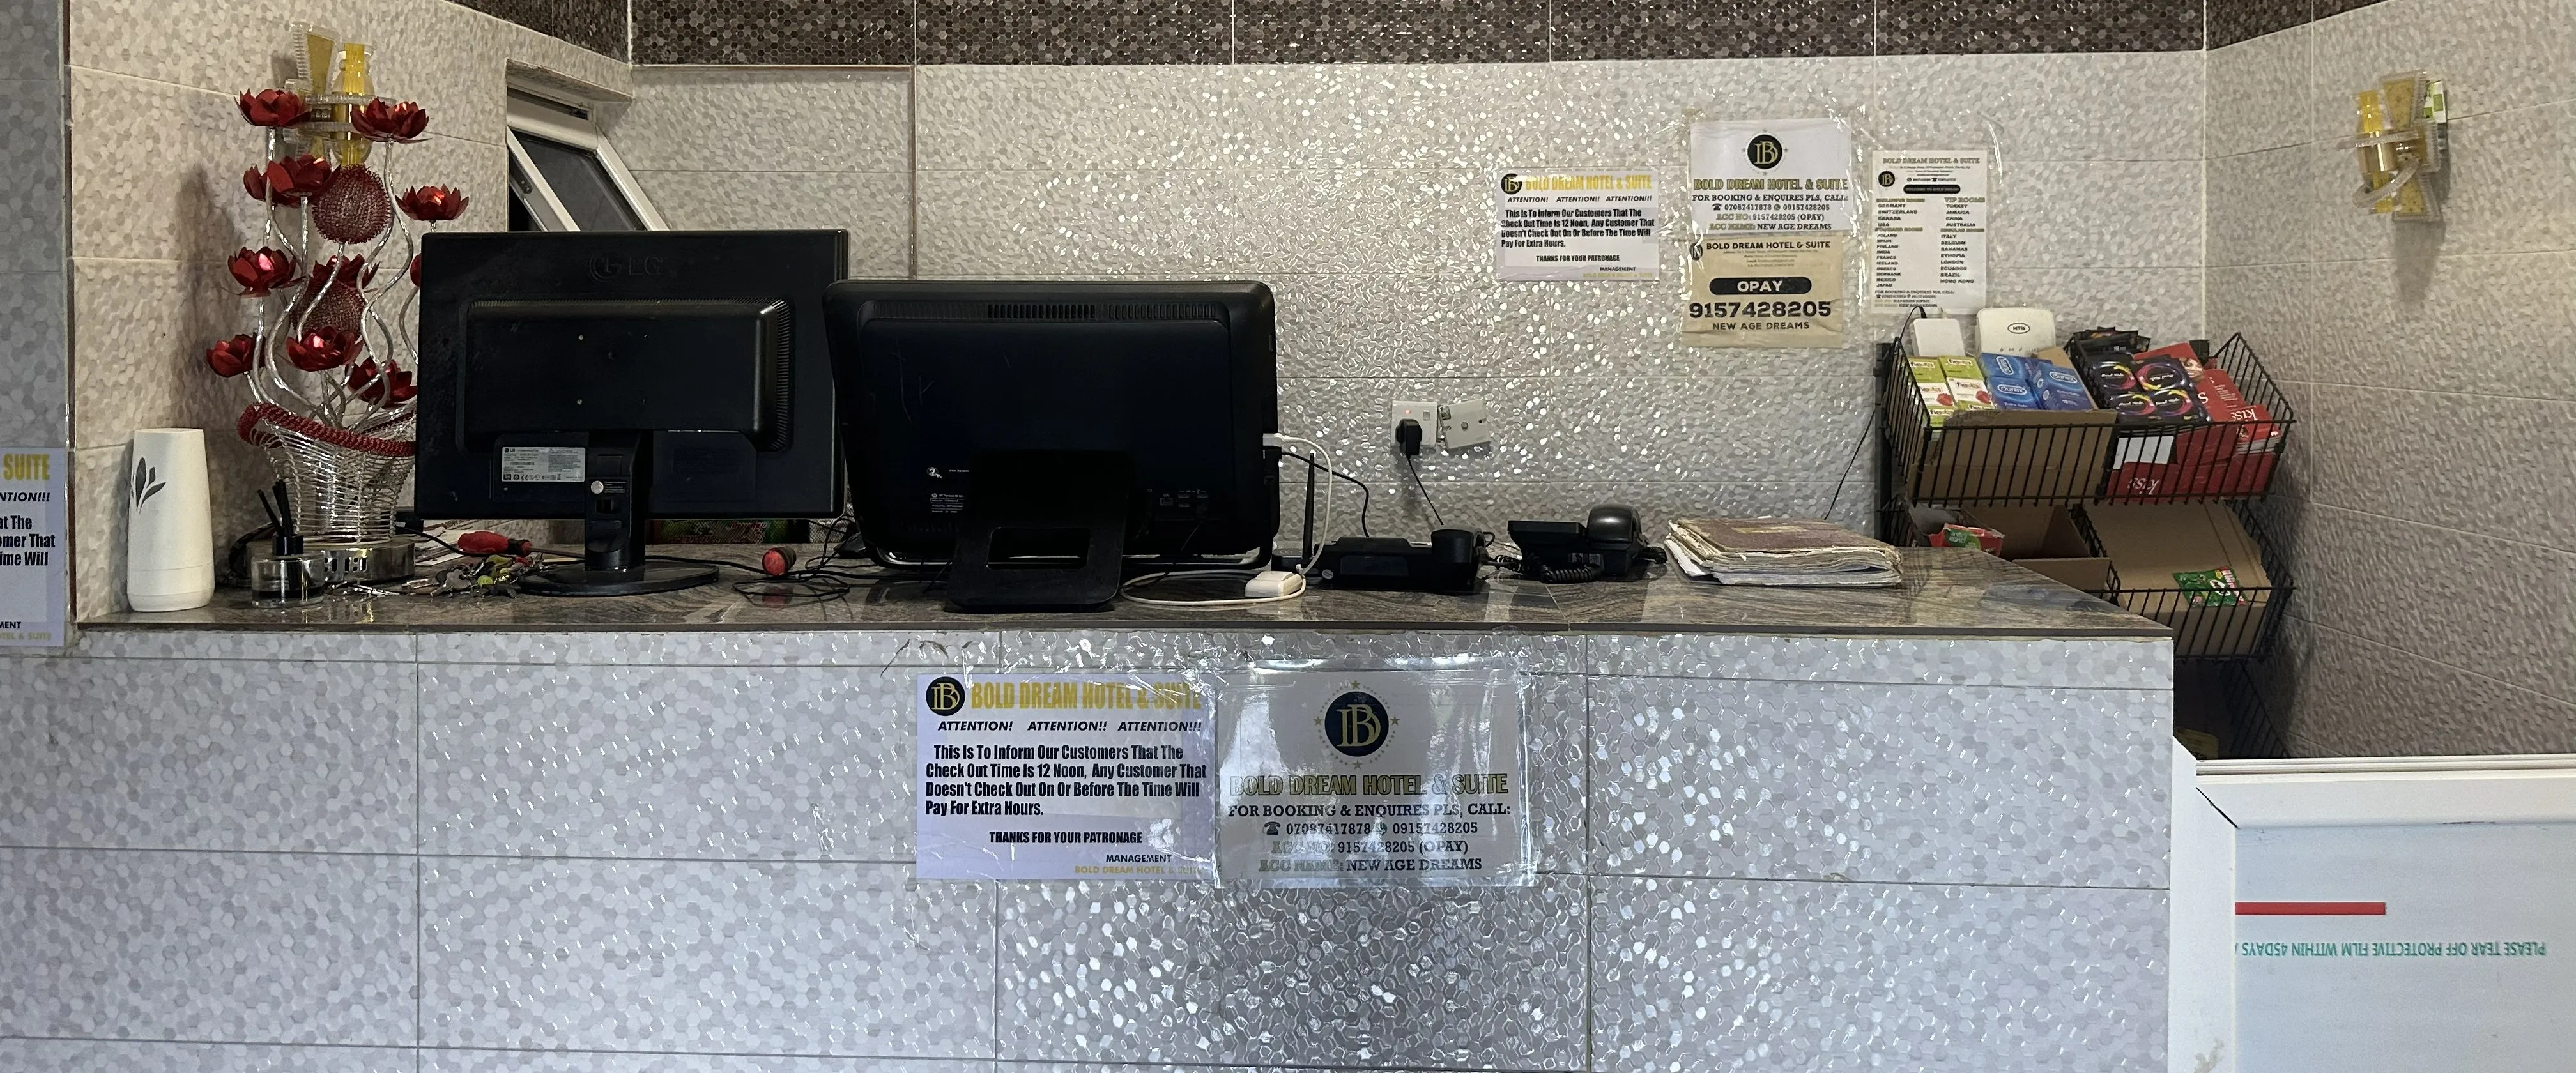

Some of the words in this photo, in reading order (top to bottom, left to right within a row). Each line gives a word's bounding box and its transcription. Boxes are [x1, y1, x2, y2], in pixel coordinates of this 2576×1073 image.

[1694, 179, 1723, 190] BOLD
[1727, 179, 1764, 190] DREAM
[1768, 179, 1802, 190] HOTEL
[1804, 179, 1813, 190] &
[1816, 179, 1848, 190] SUITE
[1505, 209, 1520, 218] This
[1538, 209, 1560, 218] Inform
[1562, 209, 1574, 218] Our
[1501, 220, 1522, 228] Check
[1523, 220, 1535, 228] Out
[1536, 220, 1552, 228] Time
[1591, 220, 1604, 228] Any
[1528, 229, 1549, 238] Check
[1550, 229, 1561, 238] Out
[1501, 240, 1514, 248] Pay
[1544, 239, 1566, 247] Hours.
[1737, 280, 1783, 292] OPAY
[1689, 301, 1831, 318] 9157428205
[4, 454, 50, 480] SUITE
[10, 515, 32, 529] The
[29, 534, 55, 547] That
[24, 552, 48, 565] Will
[971, 681, 1015, 710] BOLD
[1020, 681, 1077, 710] DREAM
[1083, 681, 1133, 710] HOTEL
[1137, 681, 1147, 710] &
[938, 721, 1013, 731] ATTENTION!
[1027, 721, 1107, 731] ATTENTION!!
[1118, 721, 1202, 731] ATTENTION!!!
[934, 744, 961, 760] This
[963, 744, 974, 760] Is
[976, 744, 992, 760] To
[993, 744, 1035, 760] Inform
[1038, 744, 1059, 760] Our
[1061, 744, 1128, 760] Customers
[1131, 744, 1158, 760] That
[1160, 744, 1183, 760] The
[926, 763, 964, 779] Check
[967, 763, 988, 779] Out
[990, 763, 1020, 779] Time
[1023, 763, 1034, 779] Is
[1038, 763, 1050, 779] 12
[1053, 763, 1087, 779] Noon,
[1091, 763, 1114, 779] Any
[1117, 763, 1177, 779] Customer
[1180, 763, 1206, 779] That
[926, 781, 972, 797] Doesn't
[974, 781, 1013, 797] Check
[1015, 781, 1036, 797] Out
[1038, 781, 1055, 797] On
[1057, 781, 1071, 797] Or
[1073, 781, 1114, 797] Before
[1117, 781, 1140, 797] The
[1142, 781, 1172, 797] Time
[1175, 781, 1199, 797] Will
[1230, 775, 1283, 795] BOLD
[1289, 775, 1357, 795] DREAM
[1363, 775, 1427, 795] HOTEL
[1431, 774, 1447, 795] &
[1451, 773, 1508, 794] SUITE
[926, 800, 947, 817] Pay
[950, 800, 969, 816] For
[972, 800, 1002, 816] Extra
[1004, 800, 1044, 816] Hours.
[1228, 805, 1260, 817] FOR
[1262, 805, 1337, 817] BOOKING
[1342, 805, 1351, 817] &
[1354, 805, 1429, 818] ENQUIRES
[1433, 804, 1463, 818] PLS,
[1468, 803, 1510, 815] CALL:
[1286, 822, 1370, 835] 07087417878
[1393, 822, 1478, 833] 09157428205
[990, 832, 1030, 844] THANKS
[1032, 832, 1052, 844] FOR
[1054, 832, 1081, 844] YOUR
[1084, 832, 1142, 844] PATRONAGE
[1338, 841, 1415, 853] 9157428205
[1419, 839, 1468, 855] (OPAY)
[1106, 855, 1172, 863] MANAGEMENT
[1258, 860, 1291, 872] ACC
[1346, 860, 1380, 872] NEW
[1384, 860, 1416, 872] AGE
[1419, 858, 1482, 871] DREAMS
[1075, 865, 1099, 874] BOLD
[1102, 865, 1133, 874] DREAM
[1137, 865, 1166, 874] HOTEL
[2242, 941, 2288, 956] 45DAYS
[2291, 941, 2338, 956] WITHIN
[2341, 941, 2369, 956] FILM
[2372, 941, 2442, 956] PROTECTIVE
[2446, 941, 2466, 956] OFF
[2471, 941, 2500, 956] TEAR
[2504, 941, 2547, 956] PLEASE
